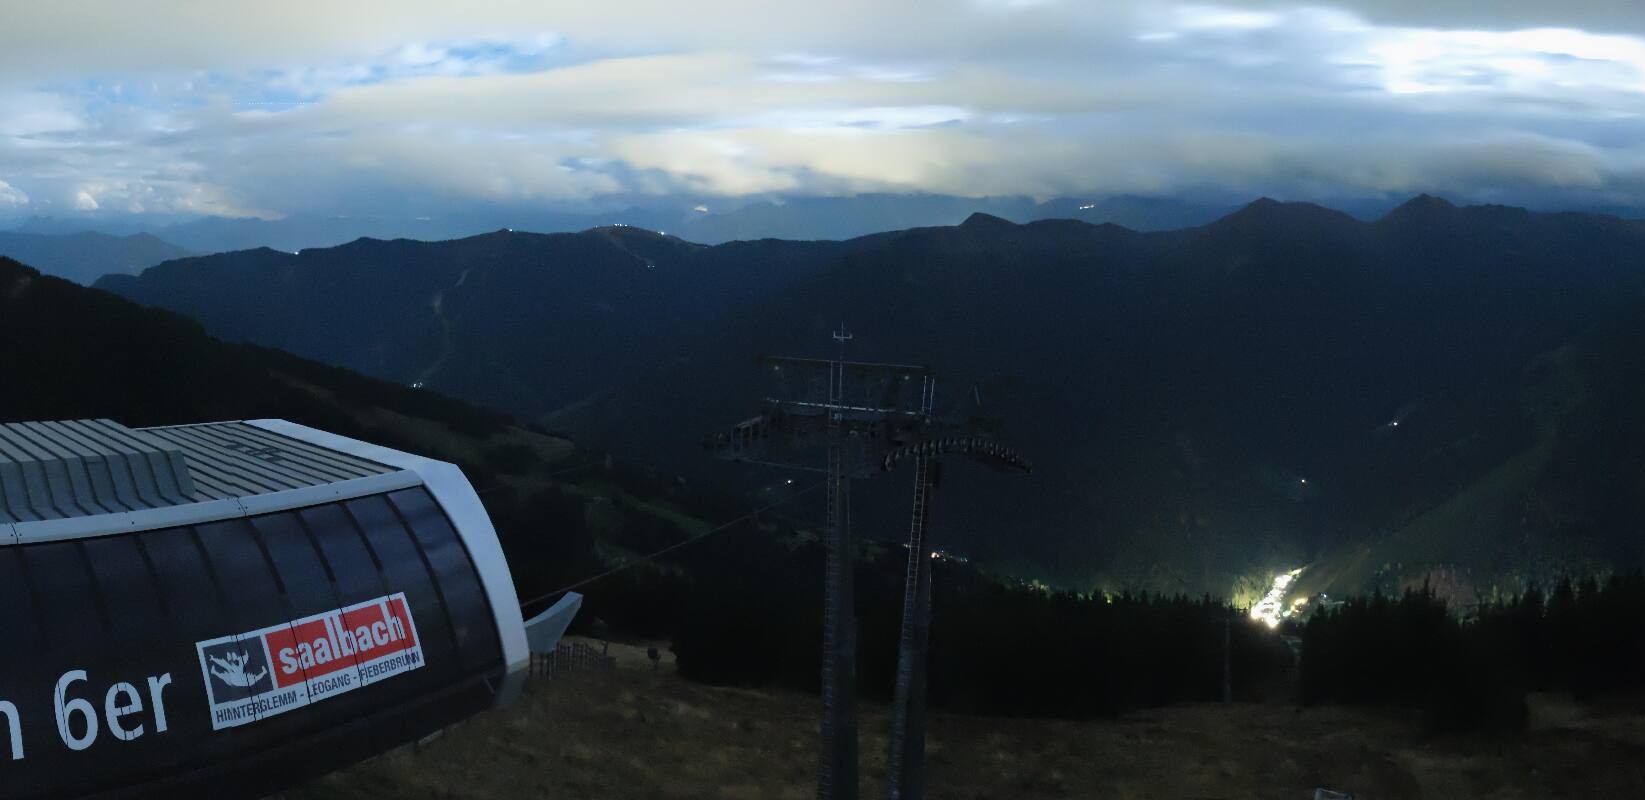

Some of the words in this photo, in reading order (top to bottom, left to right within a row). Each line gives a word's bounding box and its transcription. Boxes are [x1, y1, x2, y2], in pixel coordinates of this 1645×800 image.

[278, 600, 406, 675] saalbach
[309, 673, 351, 698] LEOGANG
[360, 651, 420, 679] FIEBERBRUNN
[54, 669, 172, 751] 6er
